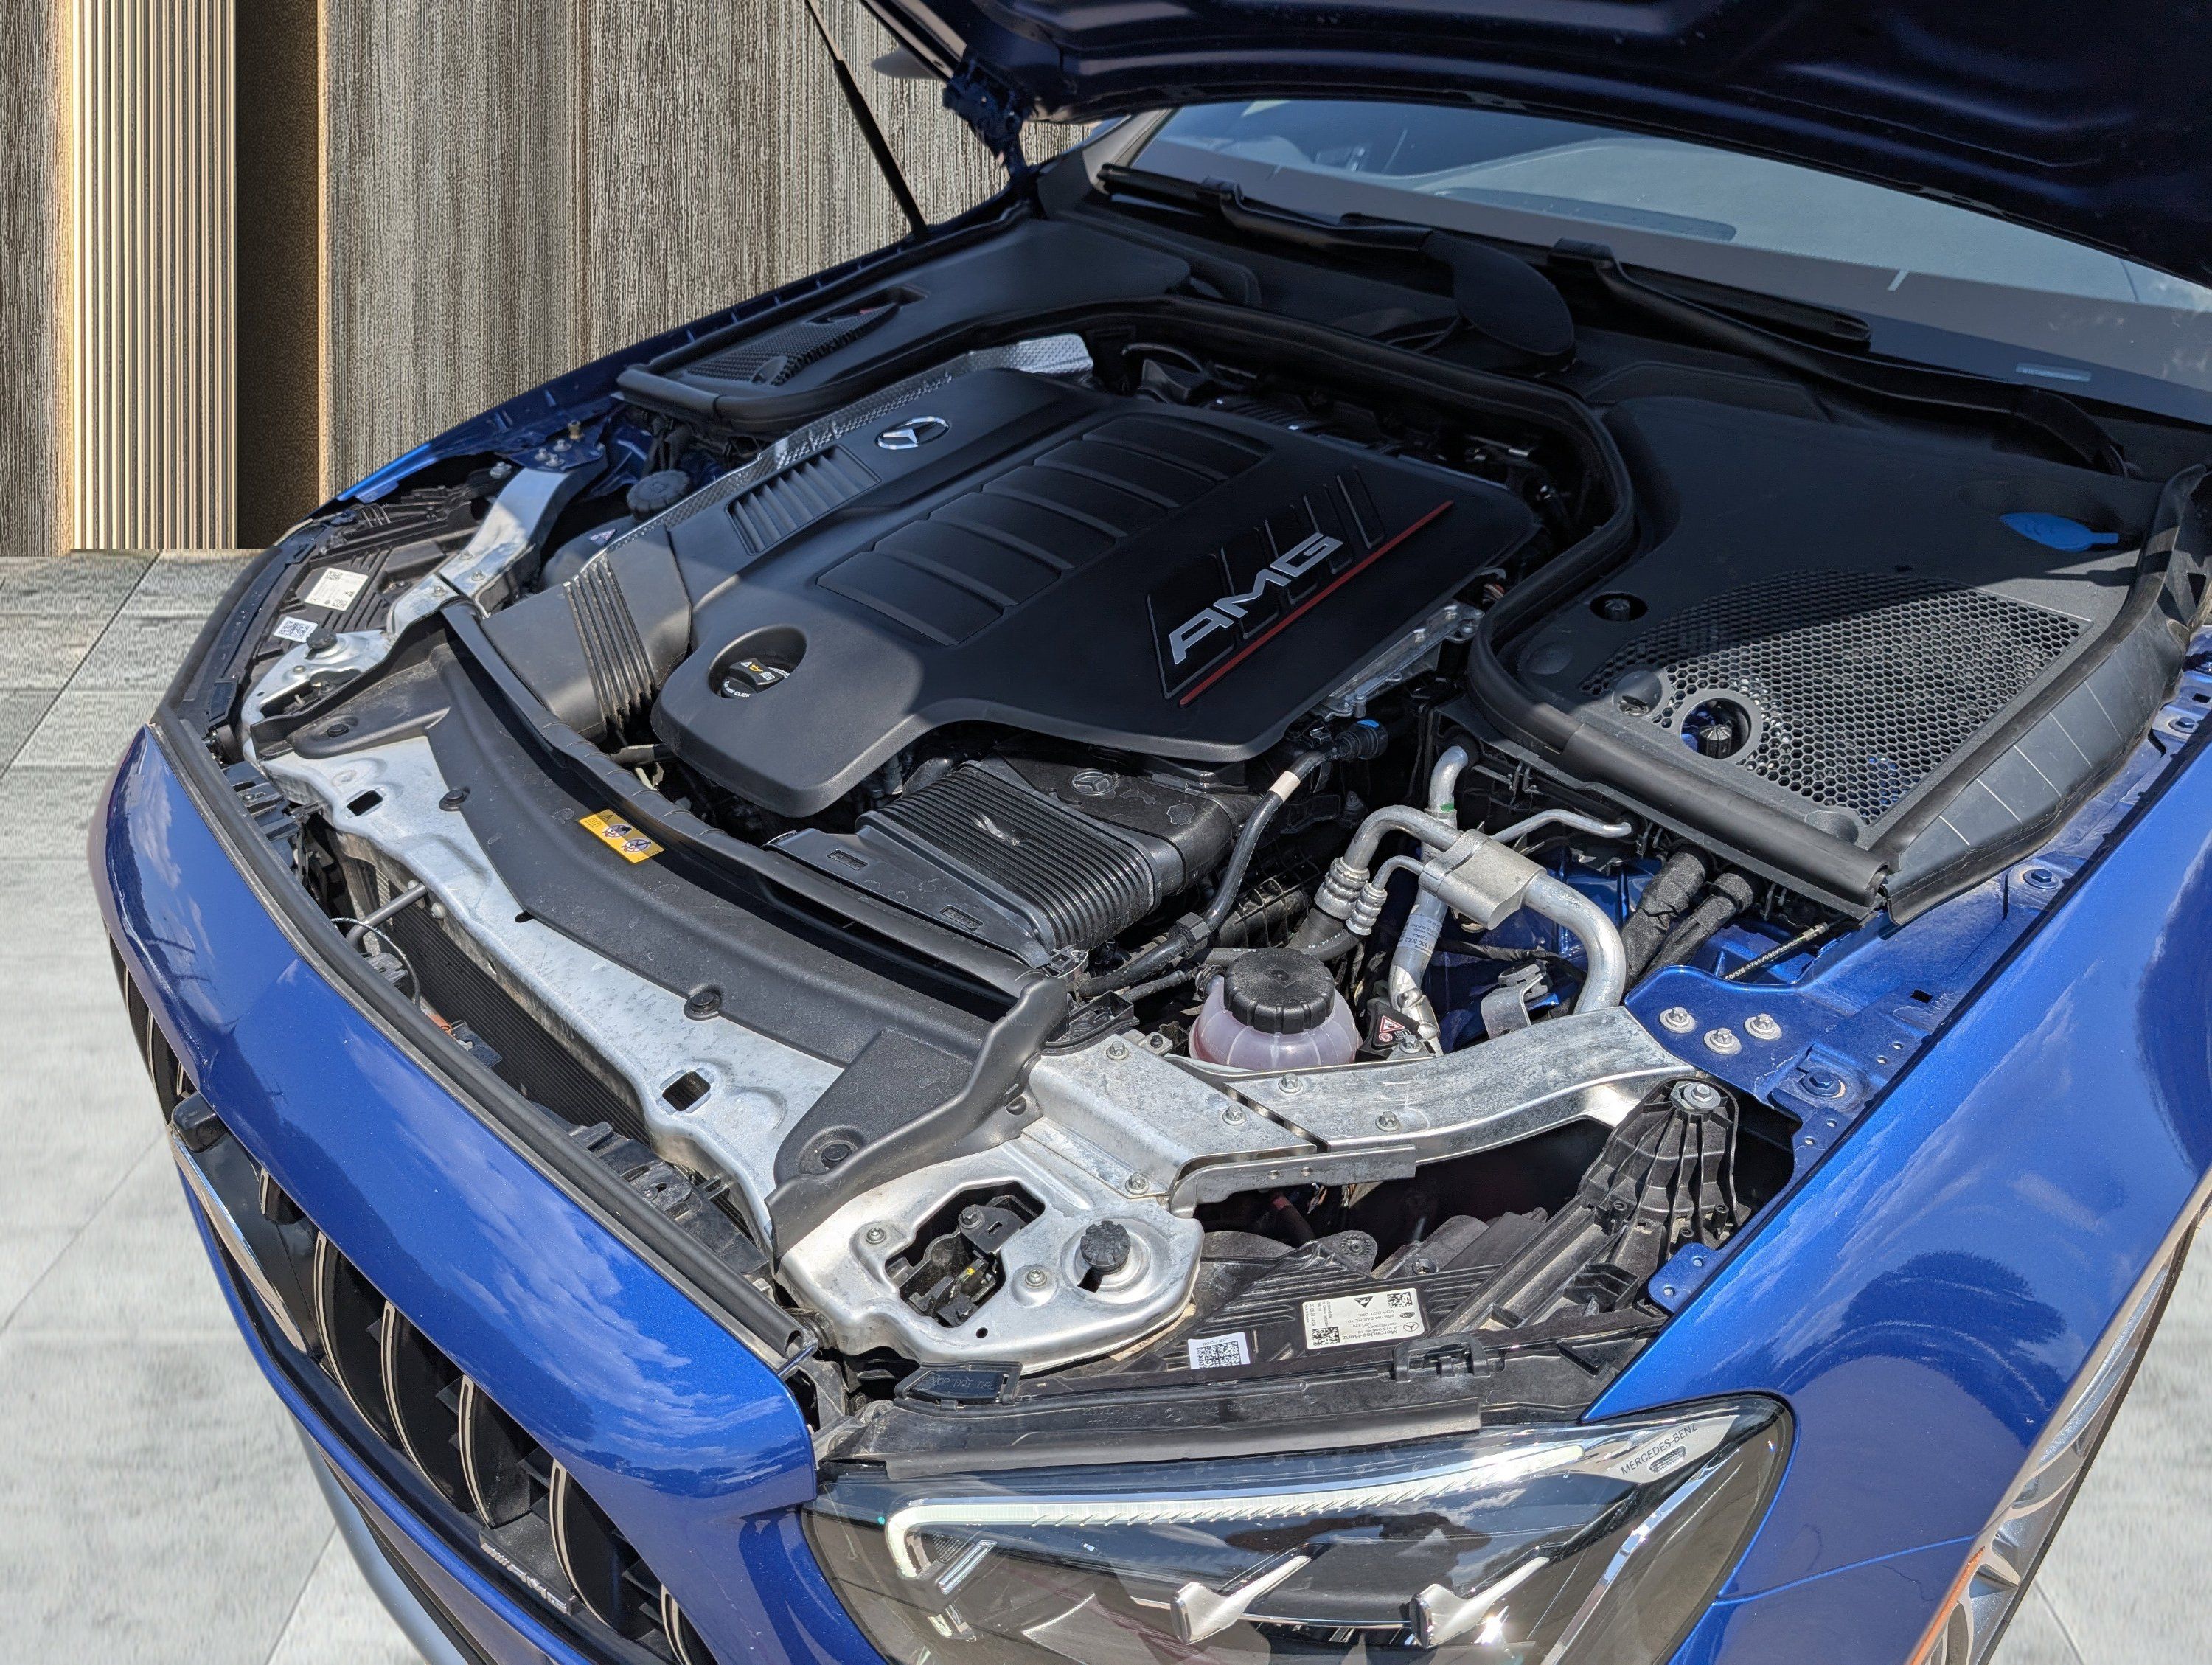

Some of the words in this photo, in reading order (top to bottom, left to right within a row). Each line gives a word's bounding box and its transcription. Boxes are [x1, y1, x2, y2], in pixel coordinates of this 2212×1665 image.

[1169, 532, 1344, 665] AMG
[1342, 1329, 1398, 1340] Mercedes-Benz
[1620, 1423, 1698, 1476] MERCEDES-BENZ
